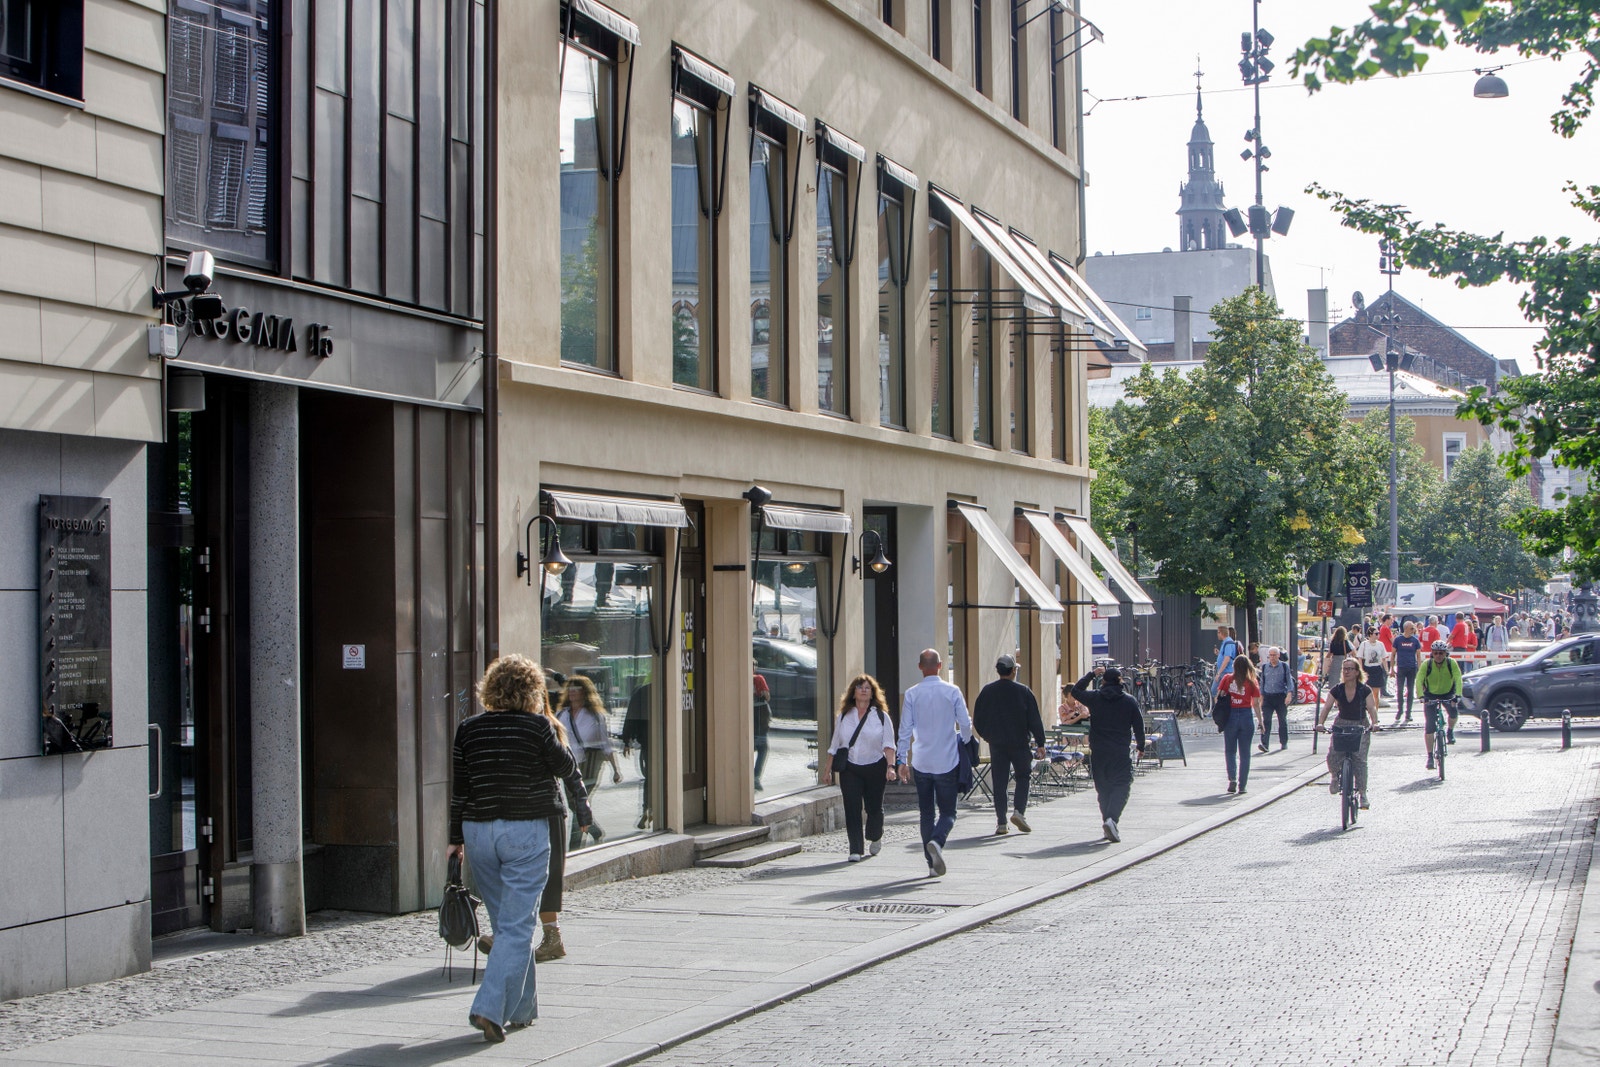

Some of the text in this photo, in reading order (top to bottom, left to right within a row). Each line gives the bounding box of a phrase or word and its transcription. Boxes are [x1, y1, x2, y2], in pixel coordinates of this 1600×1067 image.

[307, 322, 333, 358] 15
[47, 518, 107, 533] TORGGATA 15
[49, 568, 55, 580] 7
